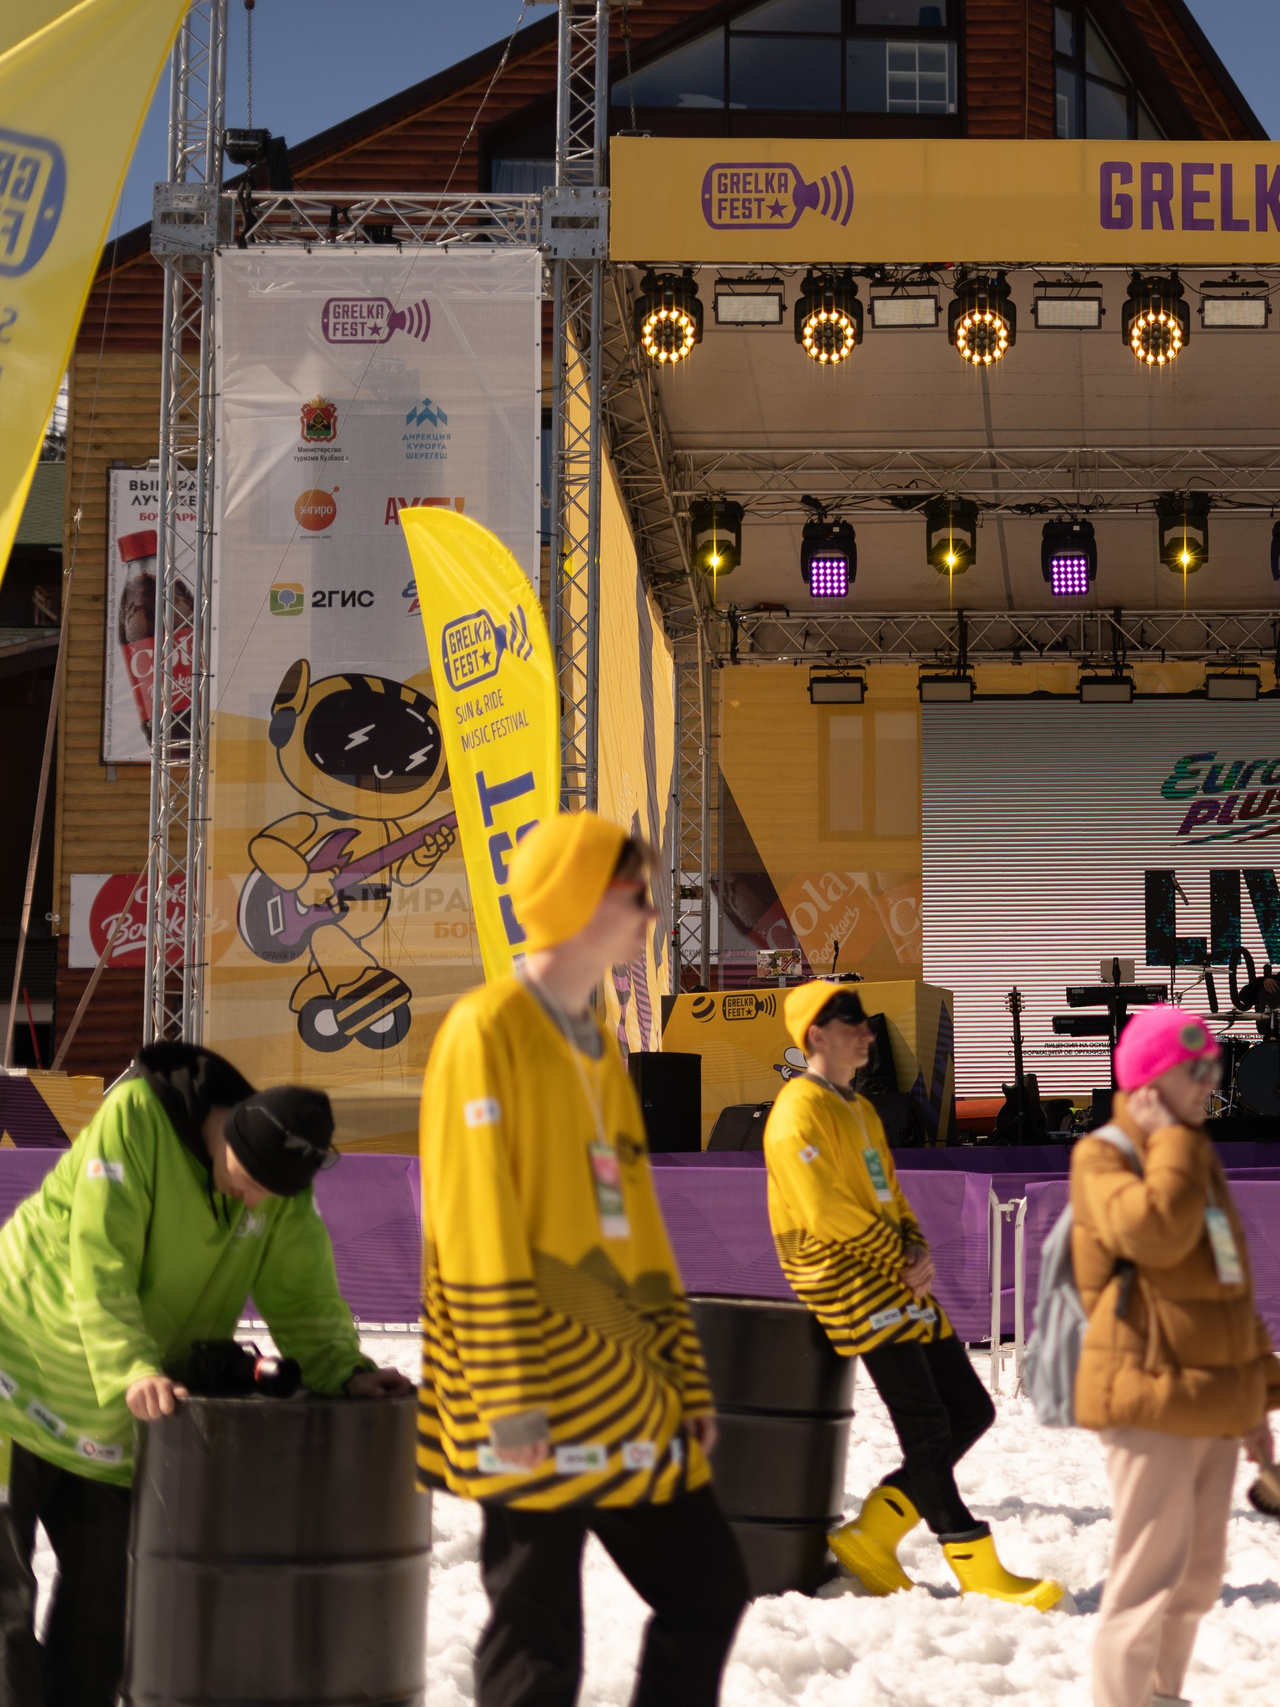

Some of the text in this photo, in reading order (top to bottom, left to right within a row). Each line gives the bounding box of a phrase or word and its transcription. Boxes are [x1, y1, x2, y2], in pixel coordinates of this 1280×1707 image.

[717, 172, 788, 194] GRELKA
[717, 197, 766, 219] FEST
[332, 304, 385, 320] GRELKA
[332, 321, 368, 337] FEST
[402, 433, 451, 442] ДИРЕКЦИЯ
[405, 452, 448, 460] ШЕРЕГЕШ
[298, 505, 333, 517] энгиро
[311, 589, 375, 608] 2ГИС
[448, 619, 493, 656] GRELKA
[452, 647, 481, 682] FEST
[455, 688, 505, 725] SUN & RIDE
[460, 709, 530, 753] MUSIC FESTIVAL
[313, 887, 475, 913] ВЫБИРА
[727, 997, 754, 1008] GRELKA
[727, 1007, 746, 1018] FEST
